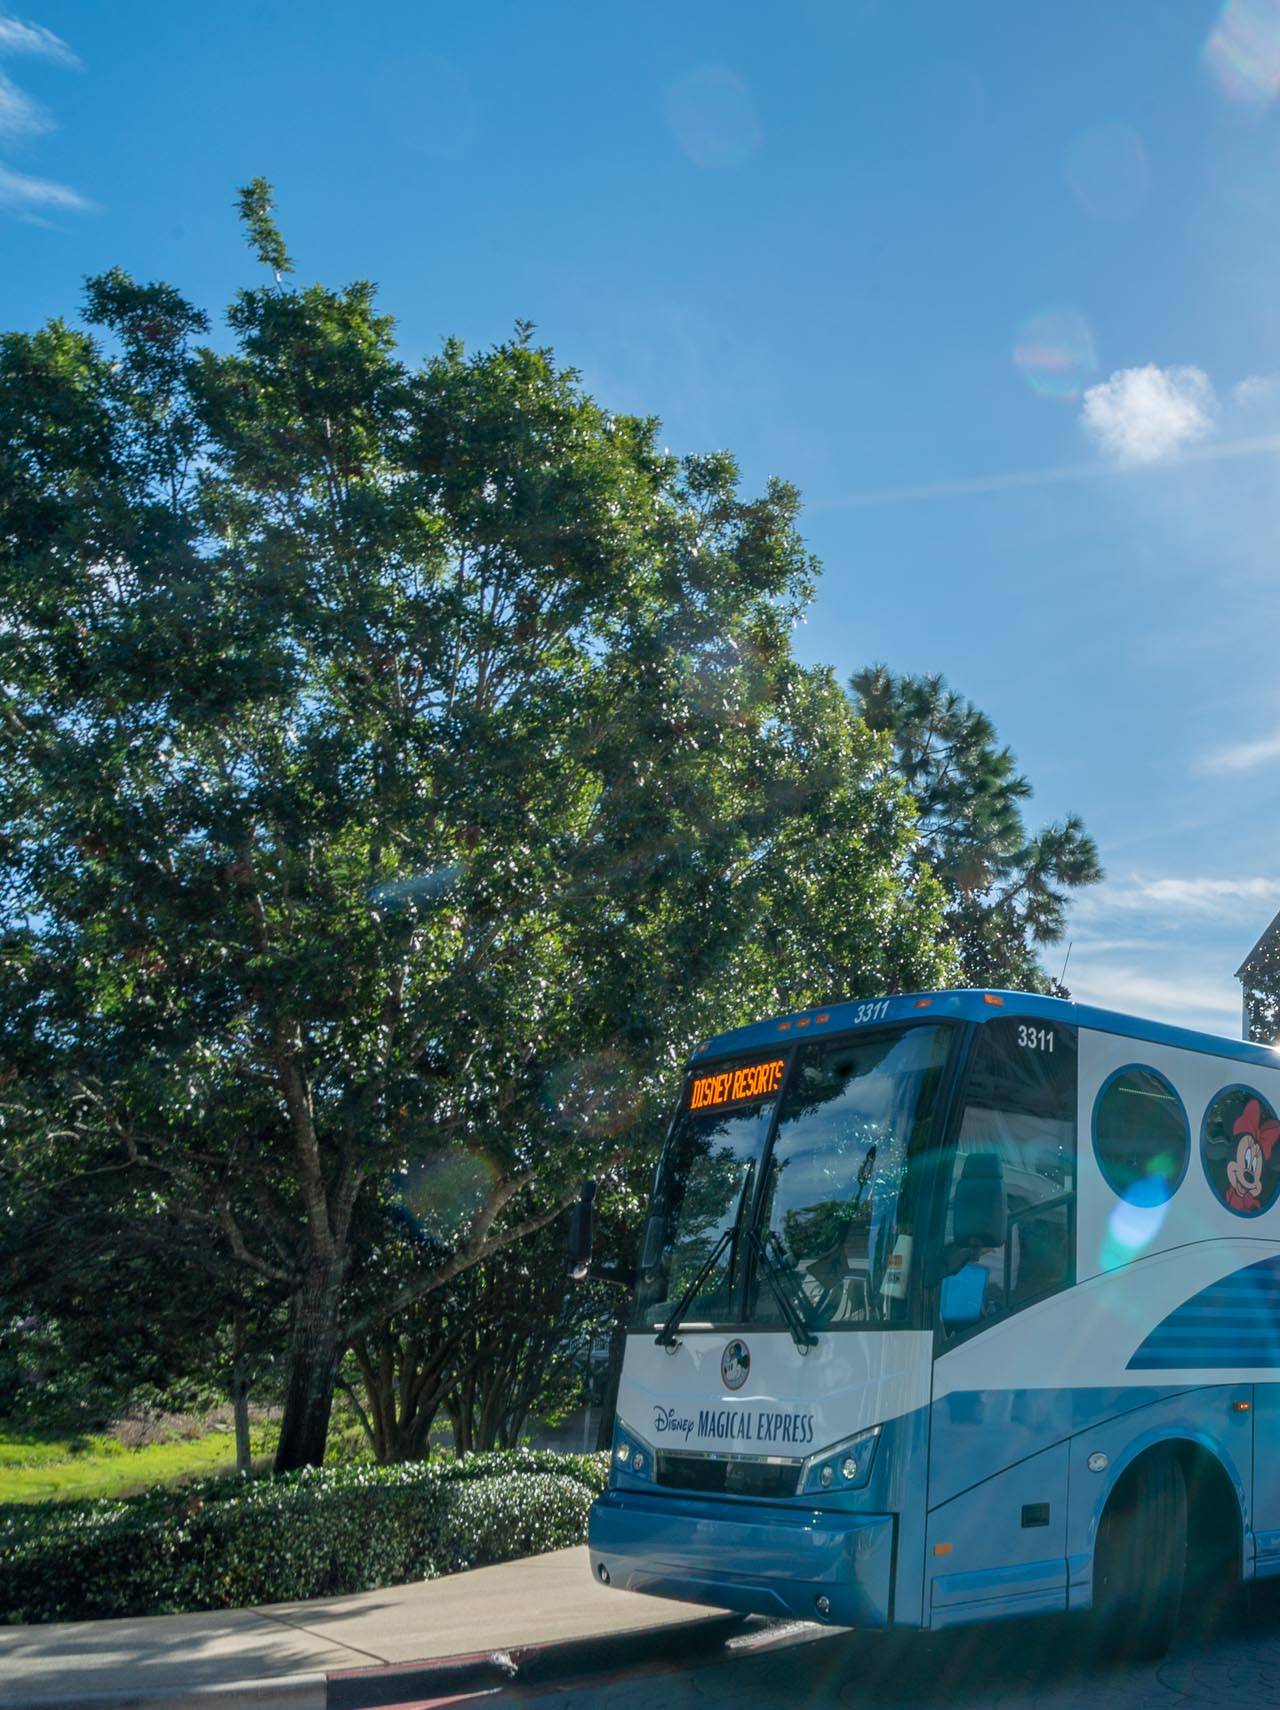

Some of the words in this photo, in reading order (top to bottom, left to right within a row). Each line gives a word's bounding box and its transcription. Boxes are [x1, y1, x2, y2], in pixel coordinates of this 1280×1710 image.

[854, 1000, 890, 1024] 3311
[1018, 1025, 1054, 1052] 3311
[690, 1072, 733, 1109] DISNEY
[732, 1060, 784, 1099] RESORTS
[698, 1410, 751, 1440] MAGICAL
[757, 1412, 814, 1443] EXPRESS
